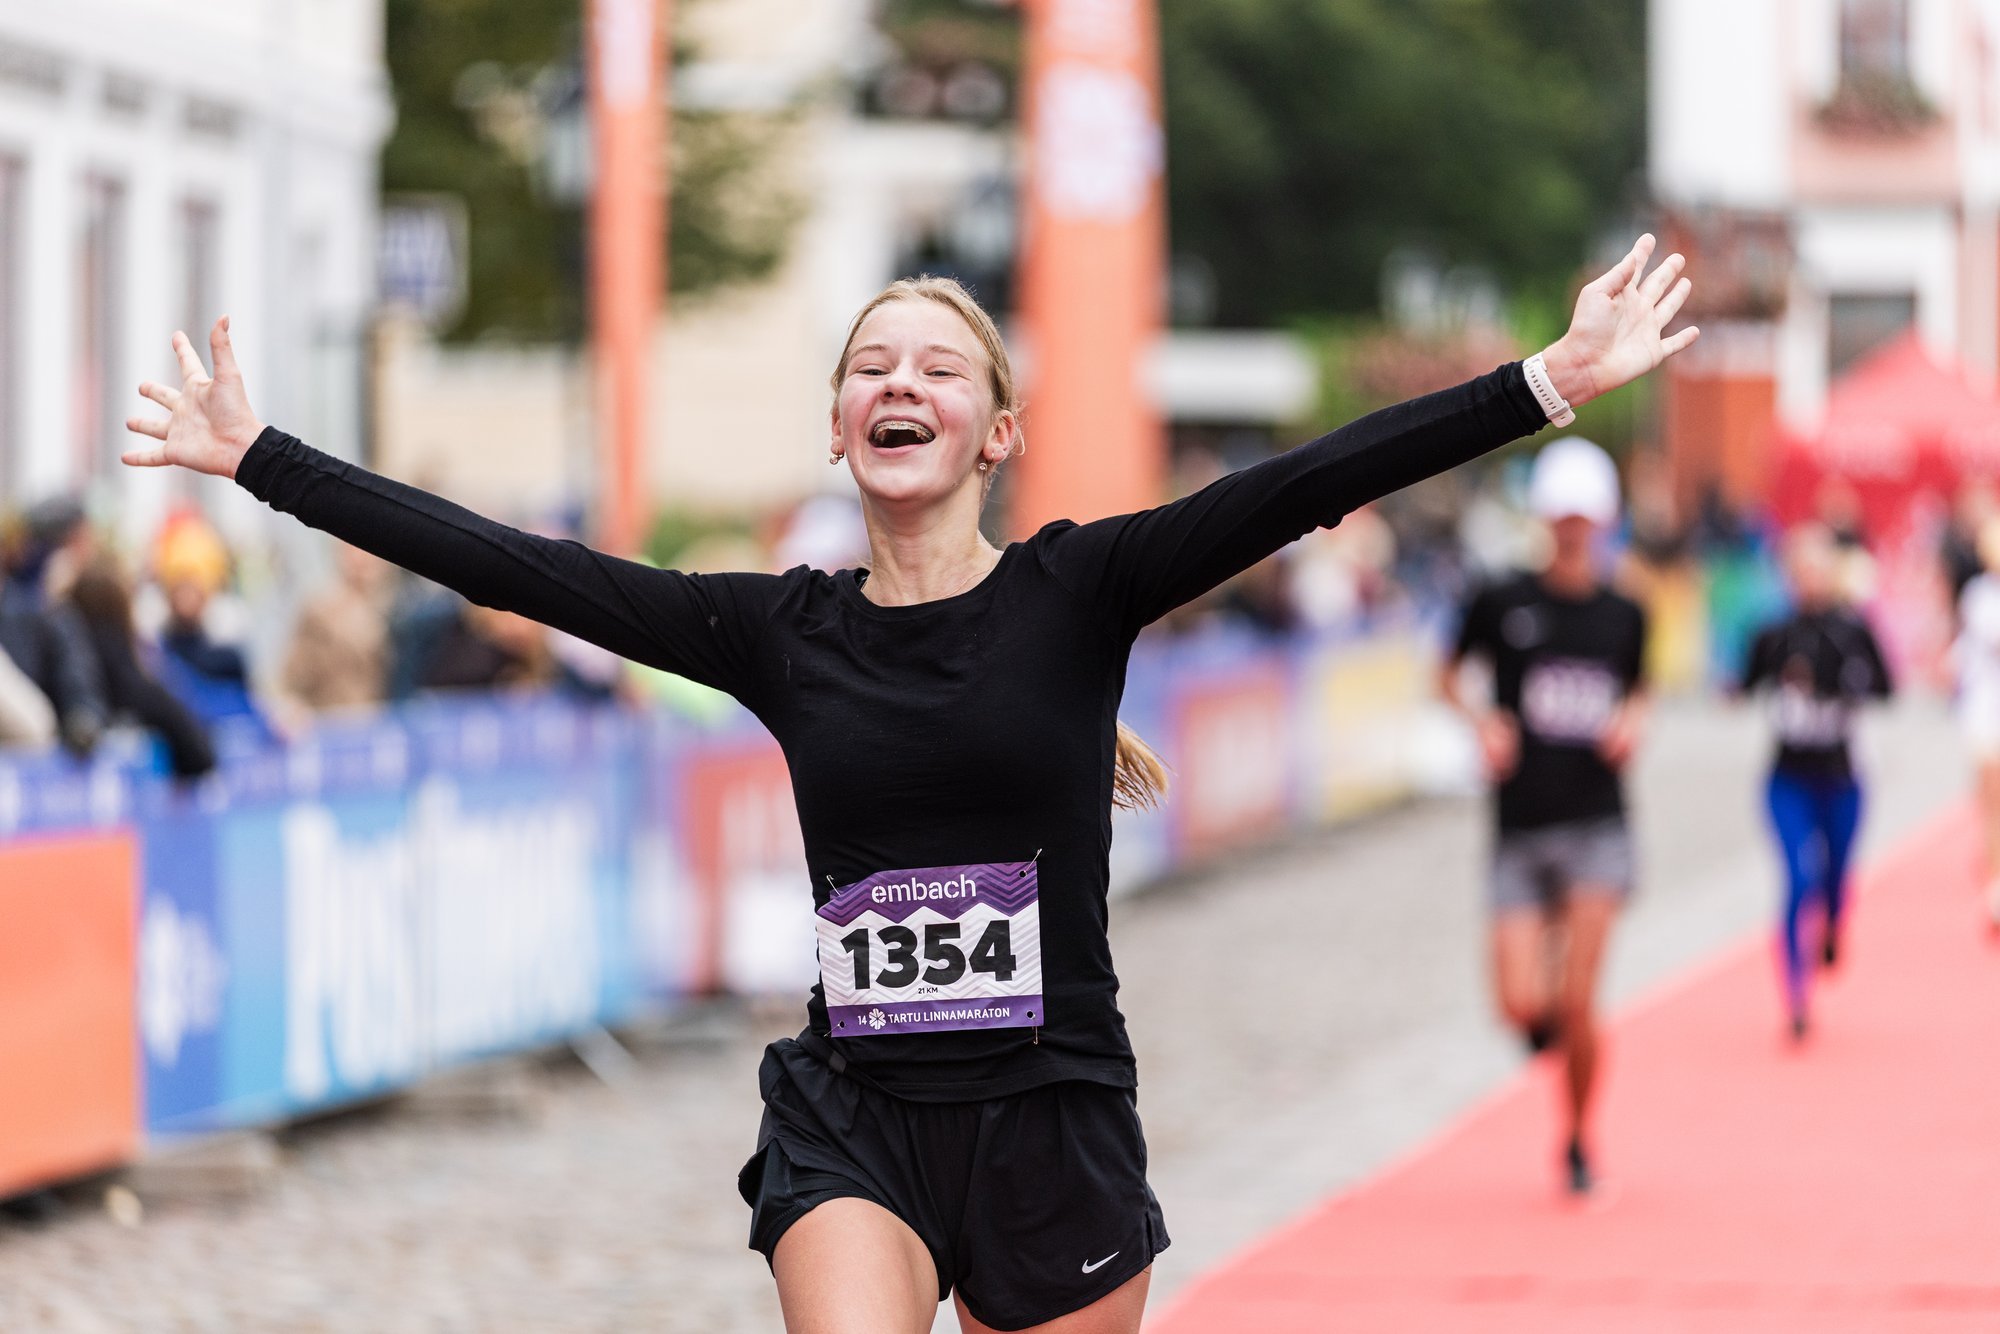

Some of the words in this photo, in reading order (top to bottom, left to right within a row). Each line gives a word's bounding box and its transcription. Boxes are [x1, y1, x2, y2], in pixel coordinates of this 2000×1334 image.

[871, 874, 976, 903] embach
[840, 920, 1016, 990] 1354
[857, 1015, 867, 1025] 14
[887, 1011, 921, 1024] TARTU
[923, 1007, 1010, 1022] LINNAMARATON
